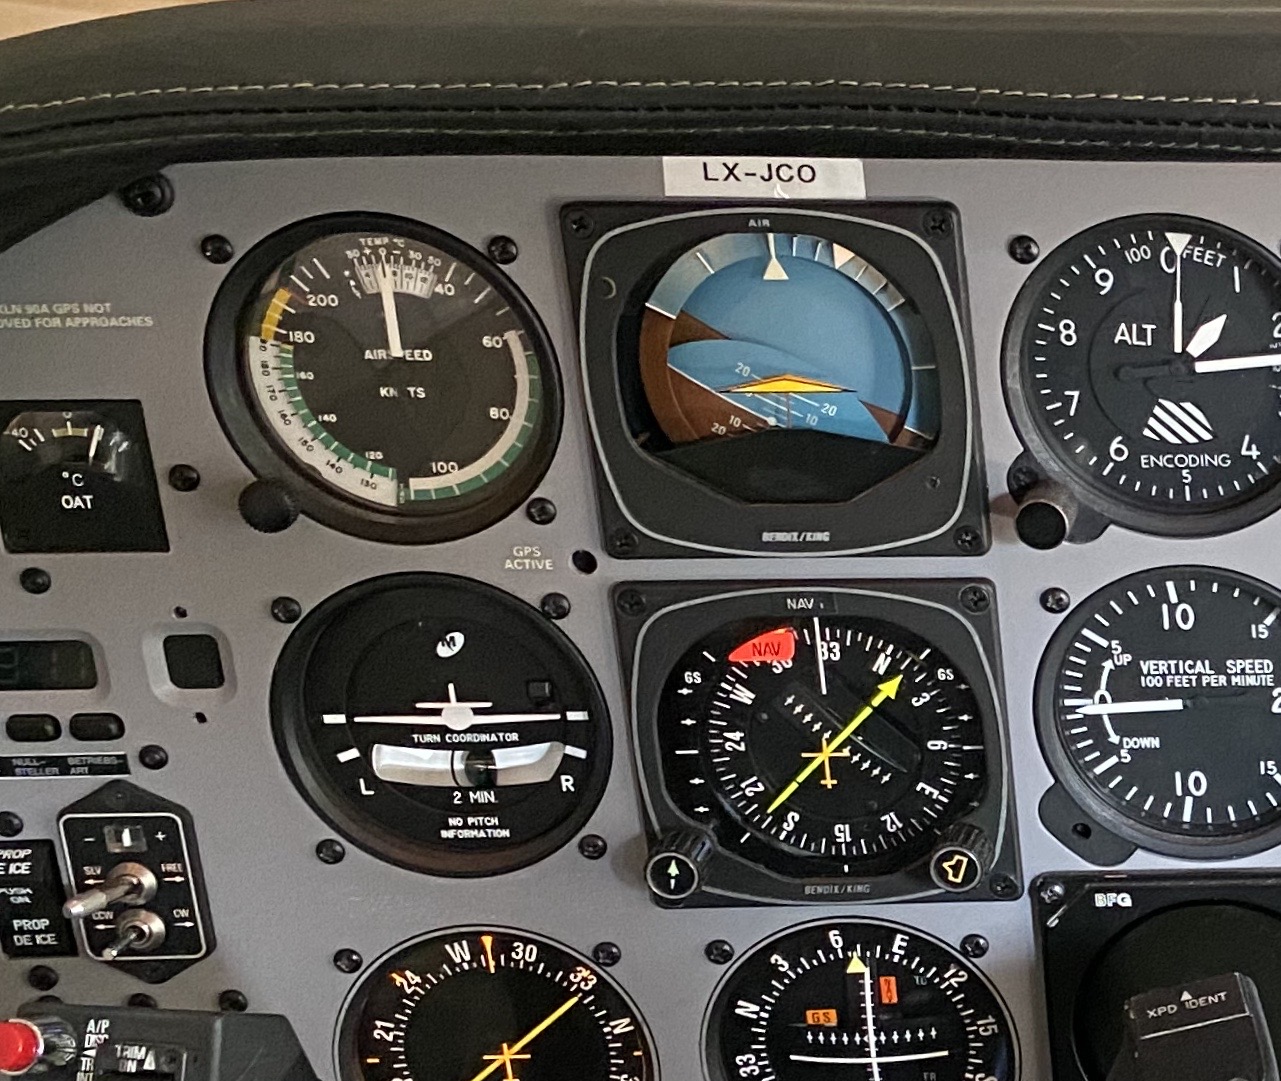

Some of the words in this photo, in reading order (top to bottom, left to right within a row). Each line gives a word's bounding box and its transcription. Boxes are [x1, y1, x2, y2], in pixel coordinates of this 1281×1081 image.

[703, 162, 815, 183] LX-JCO
[1183, 247, 1226, 267] FEET
[306, 294, 339, 307] 200
[288, 330, 315, 344] 180
[1114, 323, 1156, 345] ALT
[482, 335, 503, 349] 60
[431, 460, 458, 474] 100
[1141, 454, 1231, 468] ENCODING
[61, 494, 94, 509] OAT
[512, 546, 542, 557] GPS
[504, 558, 554, 570] ACTIVE
[1140, 660, 1215, 674] VERTICAL
[1226, 659, 1273, 673] SPEED
[411, 733, 441, 744] TURN
[445, 732, 520, 743] COORDINATOR
[1095, 893, 1132, 907] BFG
[12, 918, 50, 931] PROP
[12, 934, 33, 946] DE
[34, 933, 58, 945] ICE
[1146, 1004, 1178, 1019] XPD
[1185, 991, 1226, 1008] IDENT
